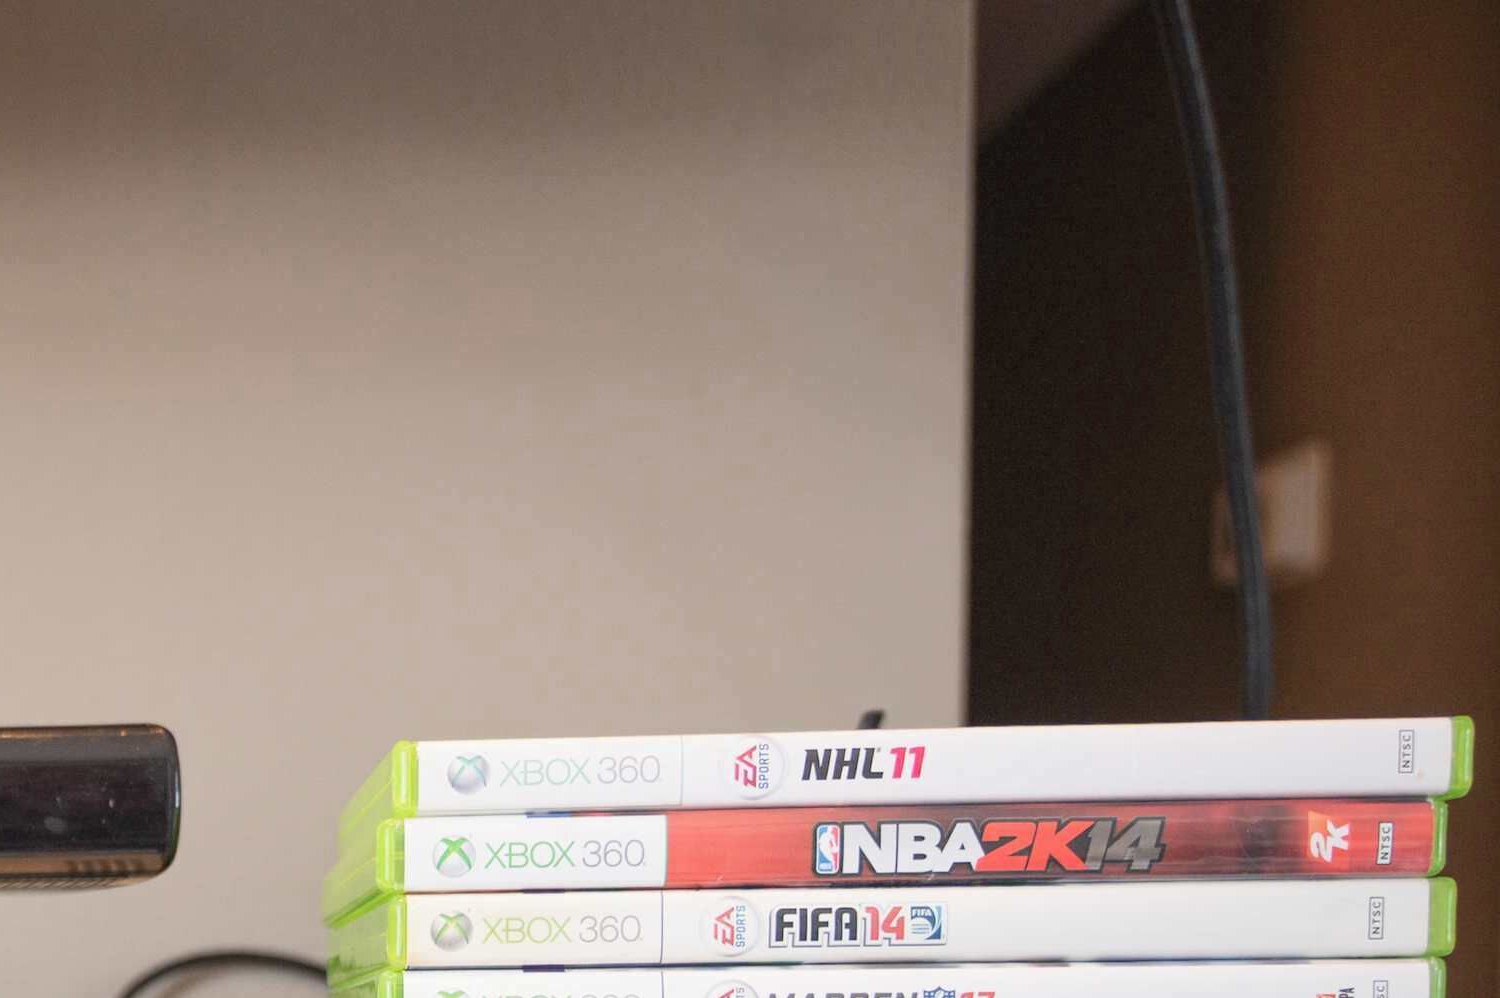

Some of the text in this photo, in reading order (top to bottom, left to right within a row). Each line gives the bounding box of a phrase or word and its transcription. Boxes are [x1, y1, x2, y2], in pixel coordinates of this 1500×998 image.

[758, 743, 770, 789] SPORTS
[801, 746, 926, 781] NHL 11
[1402, 732, 1412, 769] NTSC
[500, 755, 661, 787] XBOX 360
[484, 839, 645, 869] XBOX 360
[1310, 819, 1350, 863] 2K
[1380, 825, 1391, 861] NTSC
[735, 905, 746, 947] SPORTS
[775, 906, 906, 942] FIFA 14
[911, 905, 932, 918] FIFA
[1372, 900, 1382, 936] NTSC
[482, 915, 642, 945] XBOX 360
